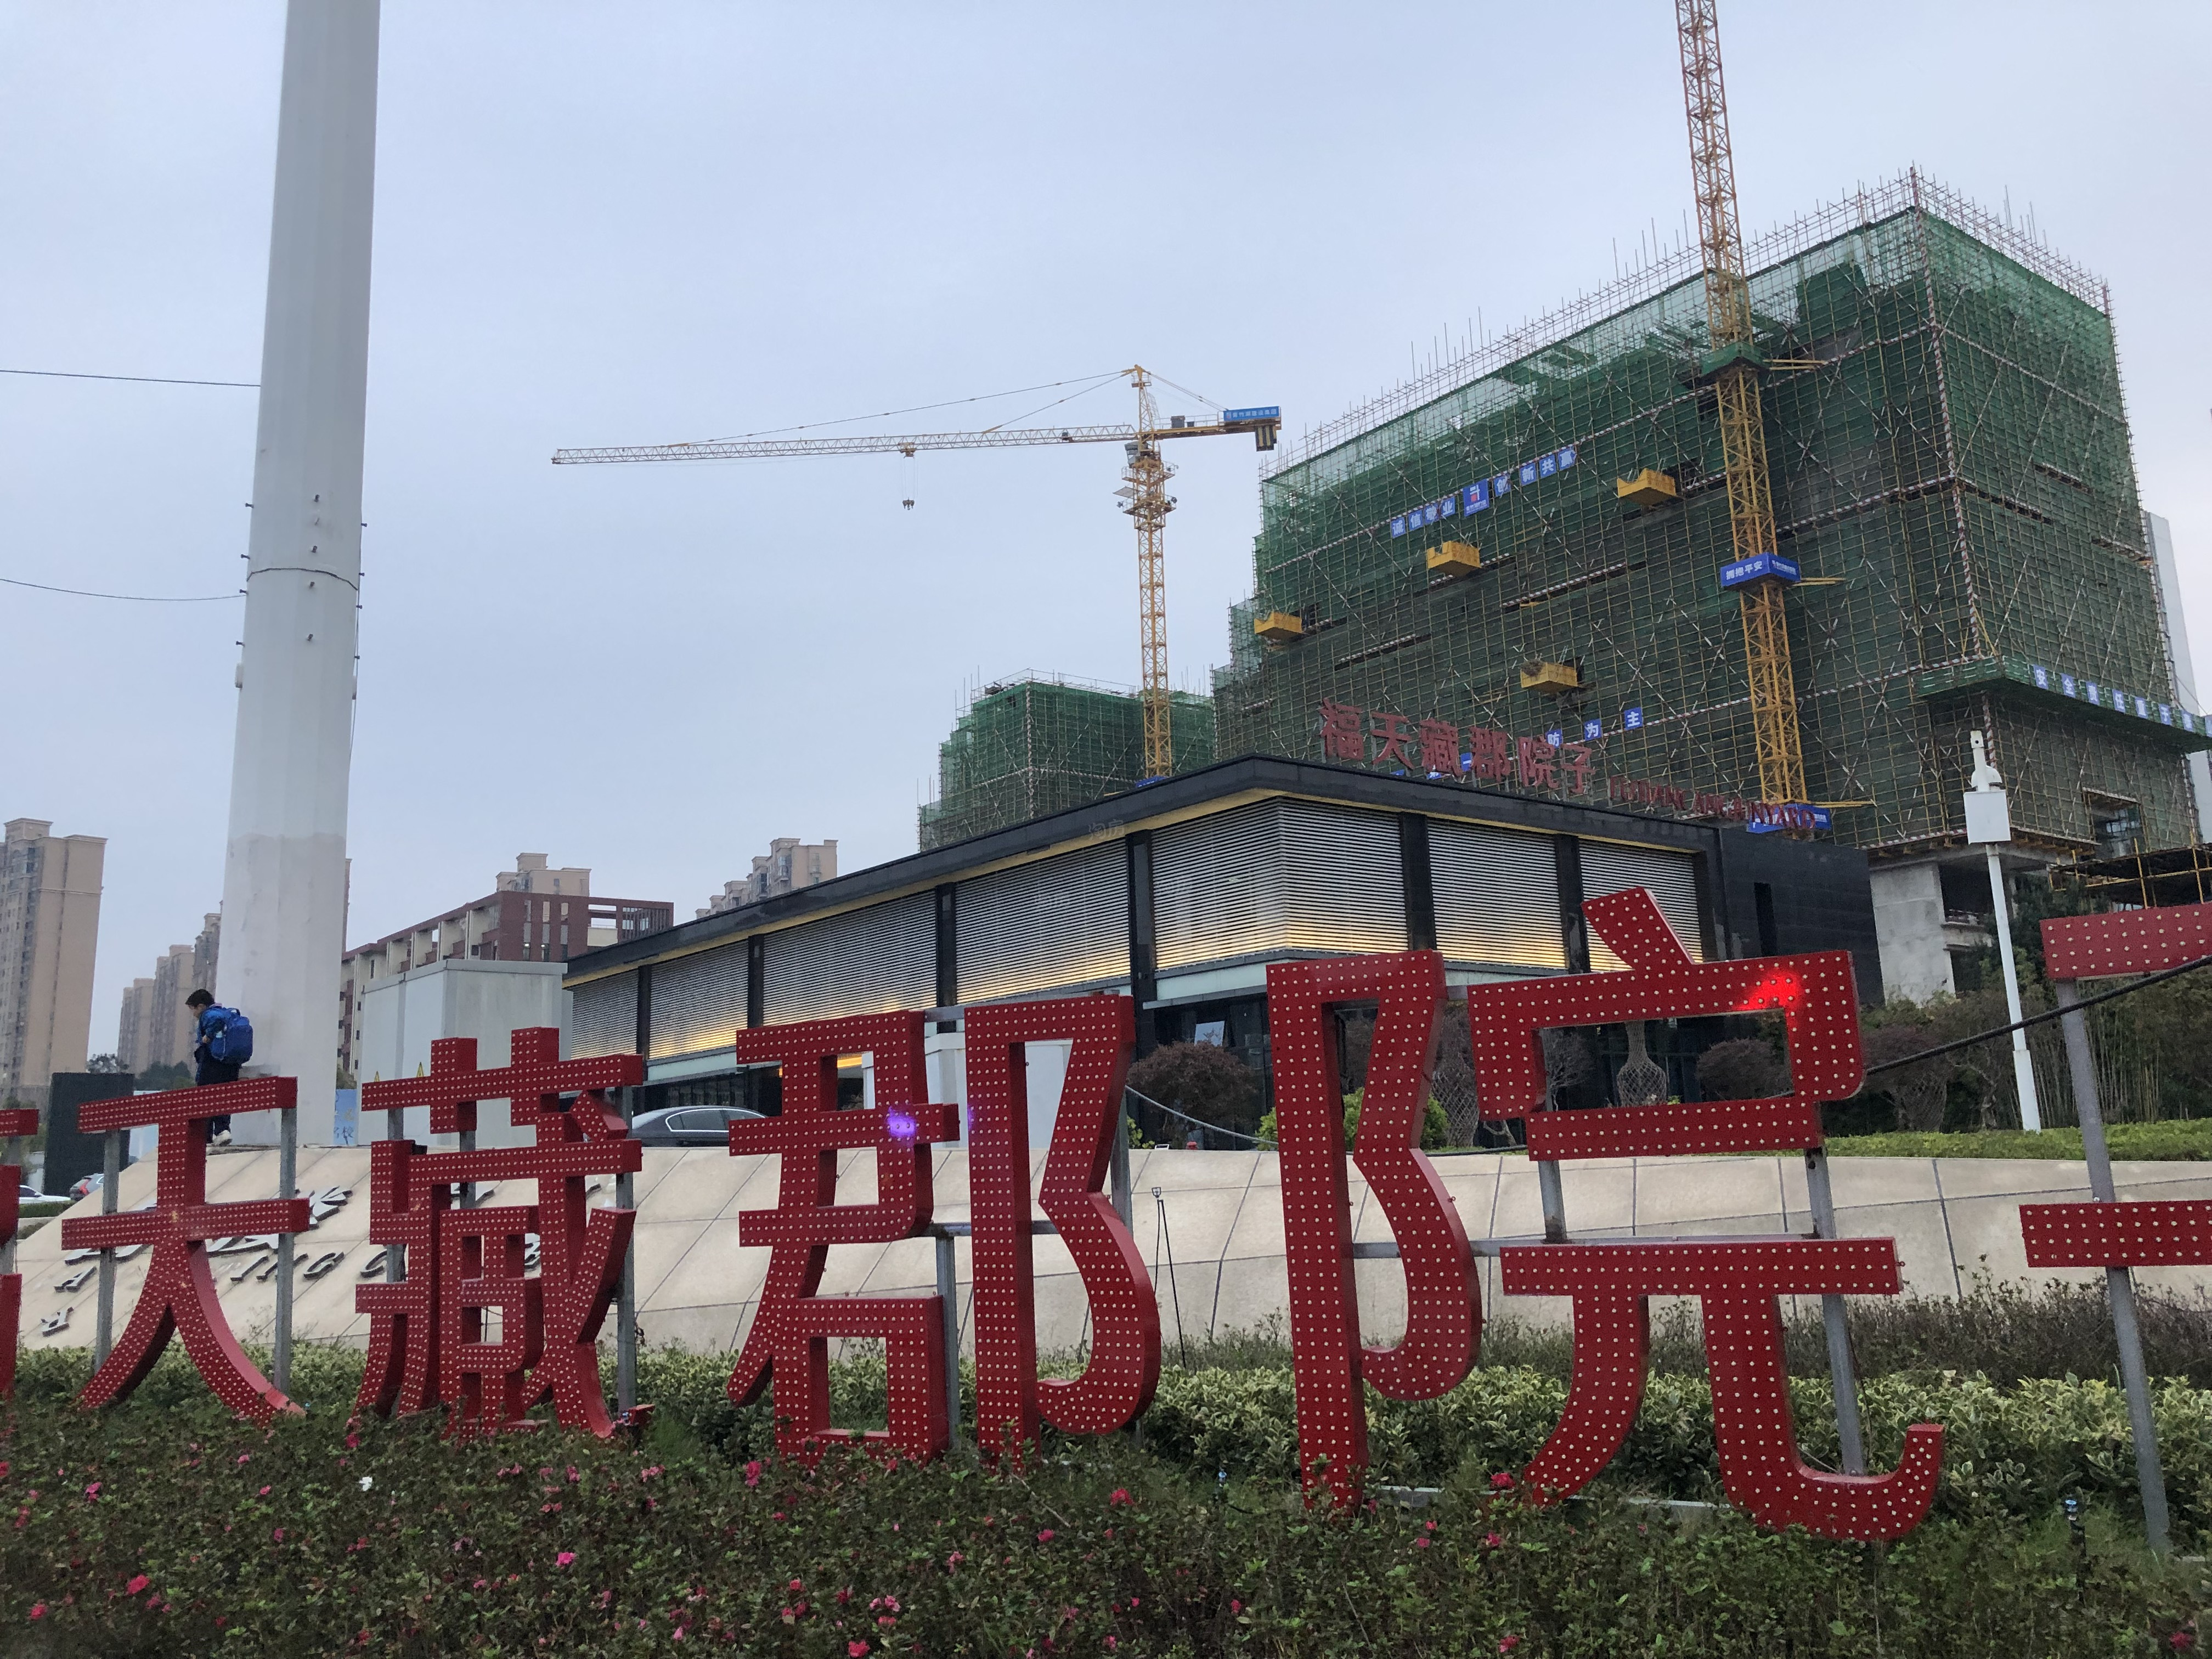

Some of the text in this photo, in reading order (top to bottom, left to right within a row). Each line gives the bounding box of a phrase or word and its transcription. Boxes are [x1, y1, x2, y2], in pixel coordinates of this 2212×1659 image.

[1319, 697, 1595, 794] 福天藏郡院子
[0, 887, 2212, 1542] 天藏郡院
